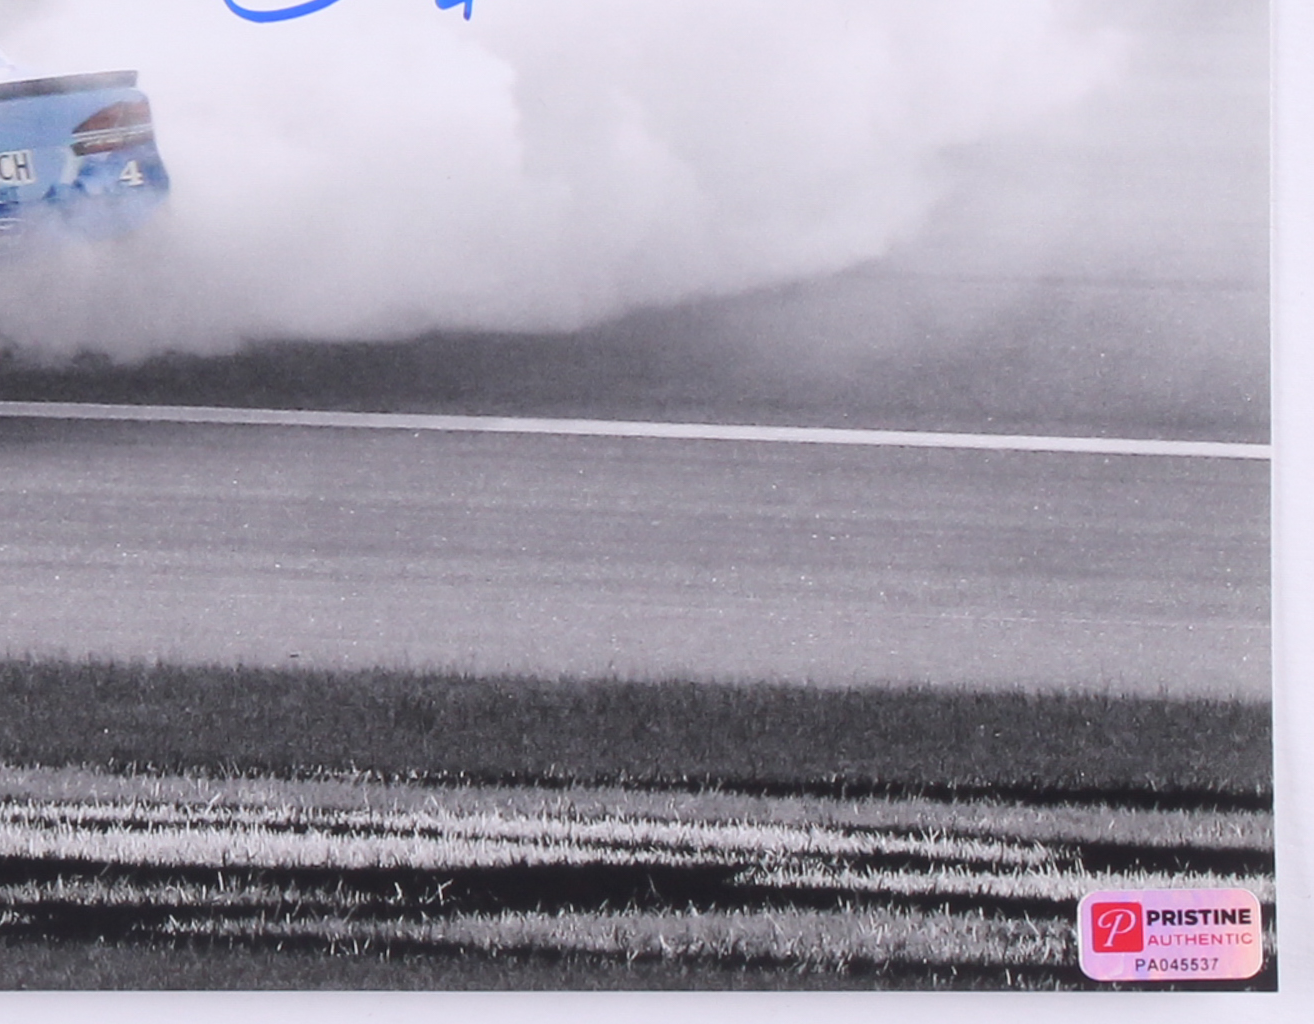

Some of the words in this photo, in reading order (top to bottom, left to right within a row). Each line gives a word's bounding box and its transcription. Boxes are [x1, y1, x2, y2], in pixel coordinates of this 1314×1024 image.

[119, 159, 145, 187] 4
[1146, 908, 1252, 926] PRISTINE
[1097, 908, 1136, 948] P
[1147, 932, 1253, 946] AUTHENTIC
[1135, 958, 1219, 972] PA045537
